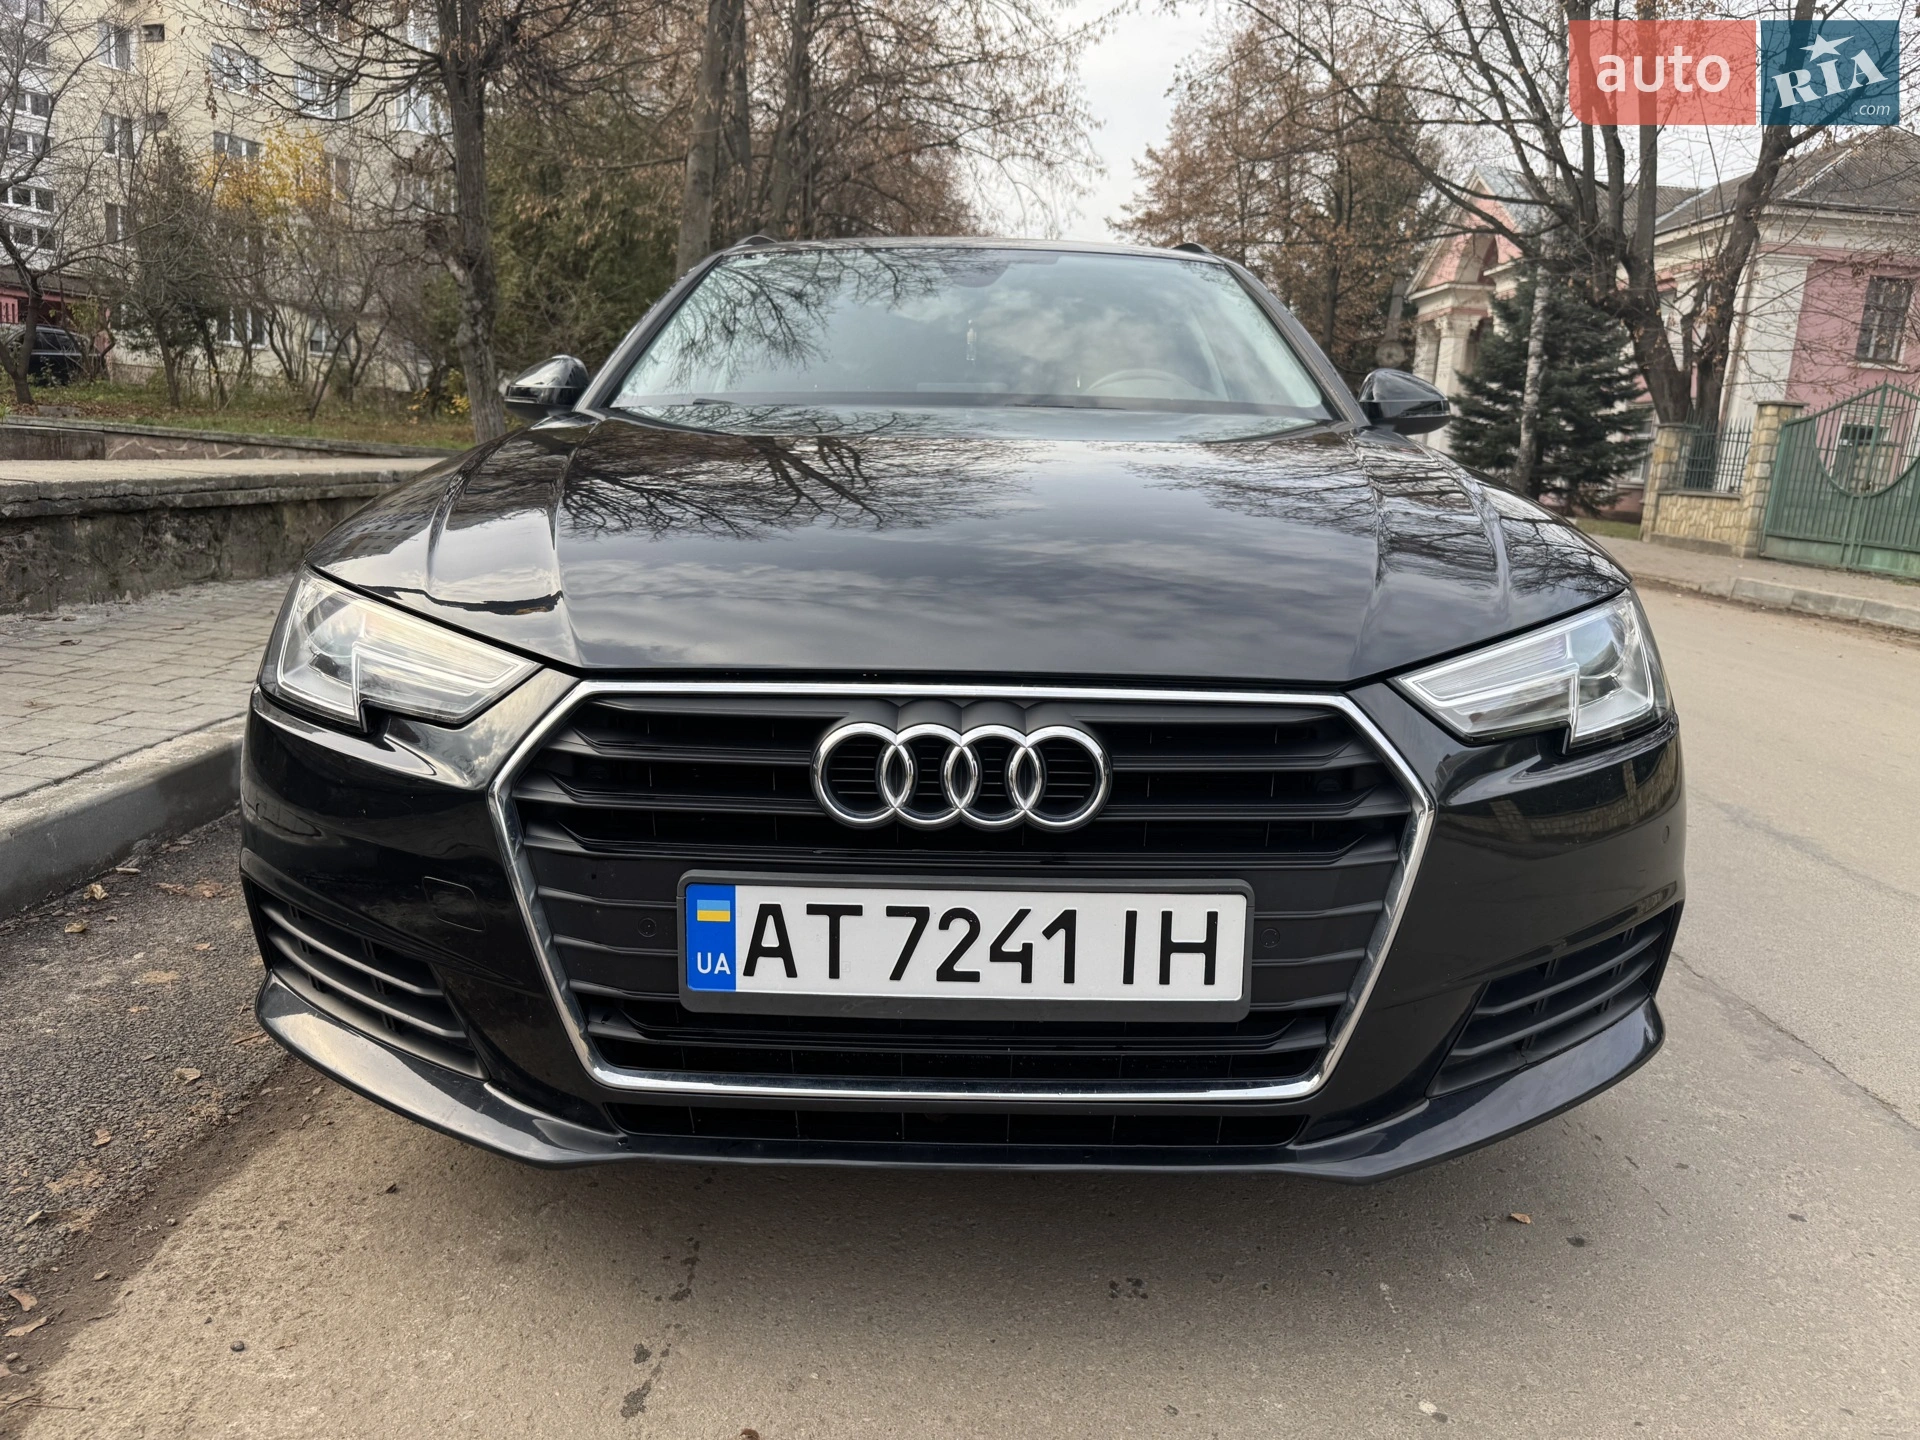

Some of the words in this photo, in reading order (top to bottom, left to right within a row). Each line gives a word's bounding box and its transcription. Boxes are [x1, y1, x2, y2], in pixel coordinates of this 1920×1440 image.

[696, 951, 732, 975] UA
[742, 902, 863, 980] AT
[885, 906, 1078, 984] 7241
[1122, 909, 1219, 986] IH
